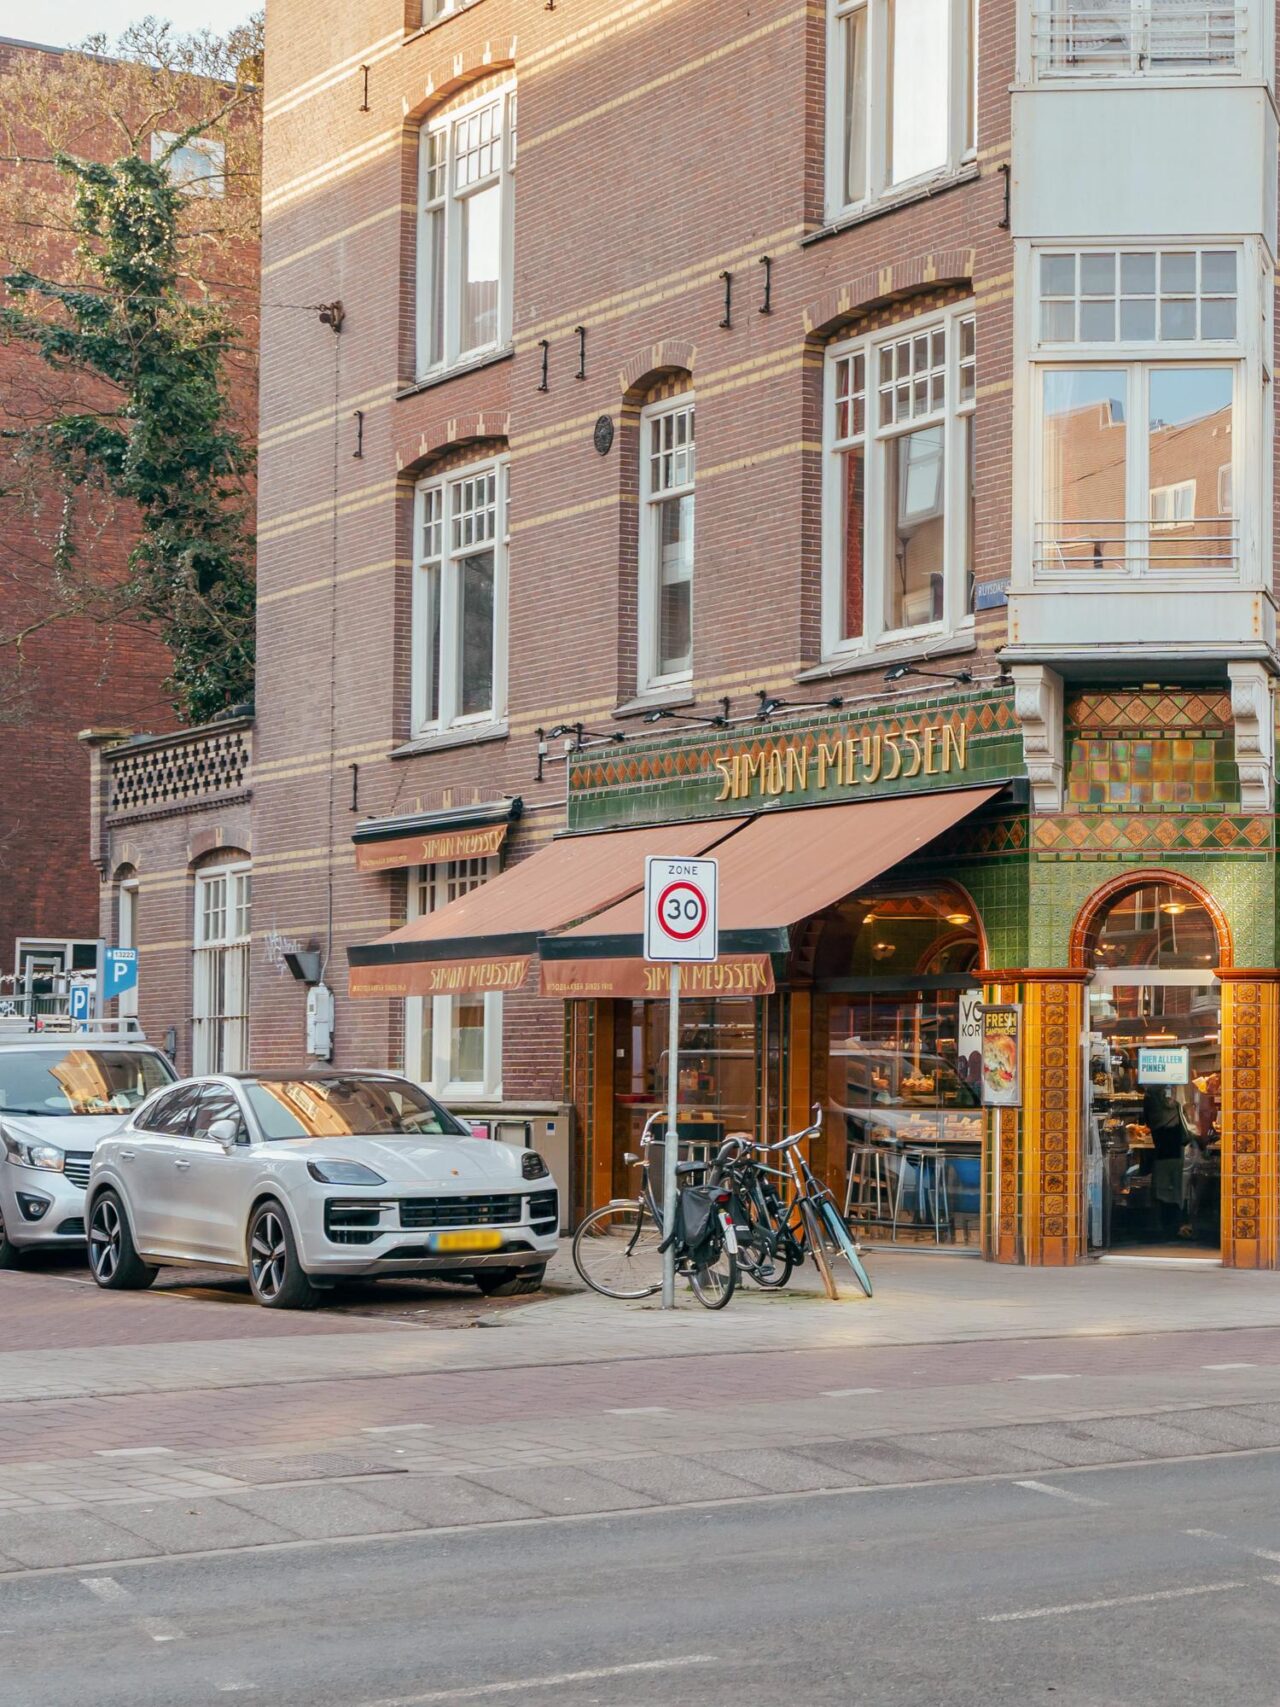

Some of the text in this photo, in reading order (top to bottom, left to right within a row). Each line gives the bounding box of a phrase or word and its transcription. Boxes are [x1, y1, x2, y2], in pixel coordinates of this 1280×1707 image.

[715, 745, 808, 802] SIMON
[668, 865, 699, 876] ZONE
[667, 898, 699, 921] 30
[114, 962, 128, 983] P
[429, 967, 467, 990] SIMON
[643, 966, 688, 991] SIMN
[74, 990, 86, 1017] P
[962, 1000, 983, 1022] VO
[962, 1023, 981, 1037] KOR
[985, 1013, 1017, 1027] FRESH
[1141, 1055, 1183, 1064] HIER ALLEEN
[1141, 1063, 1166, 1072] PINNEN
